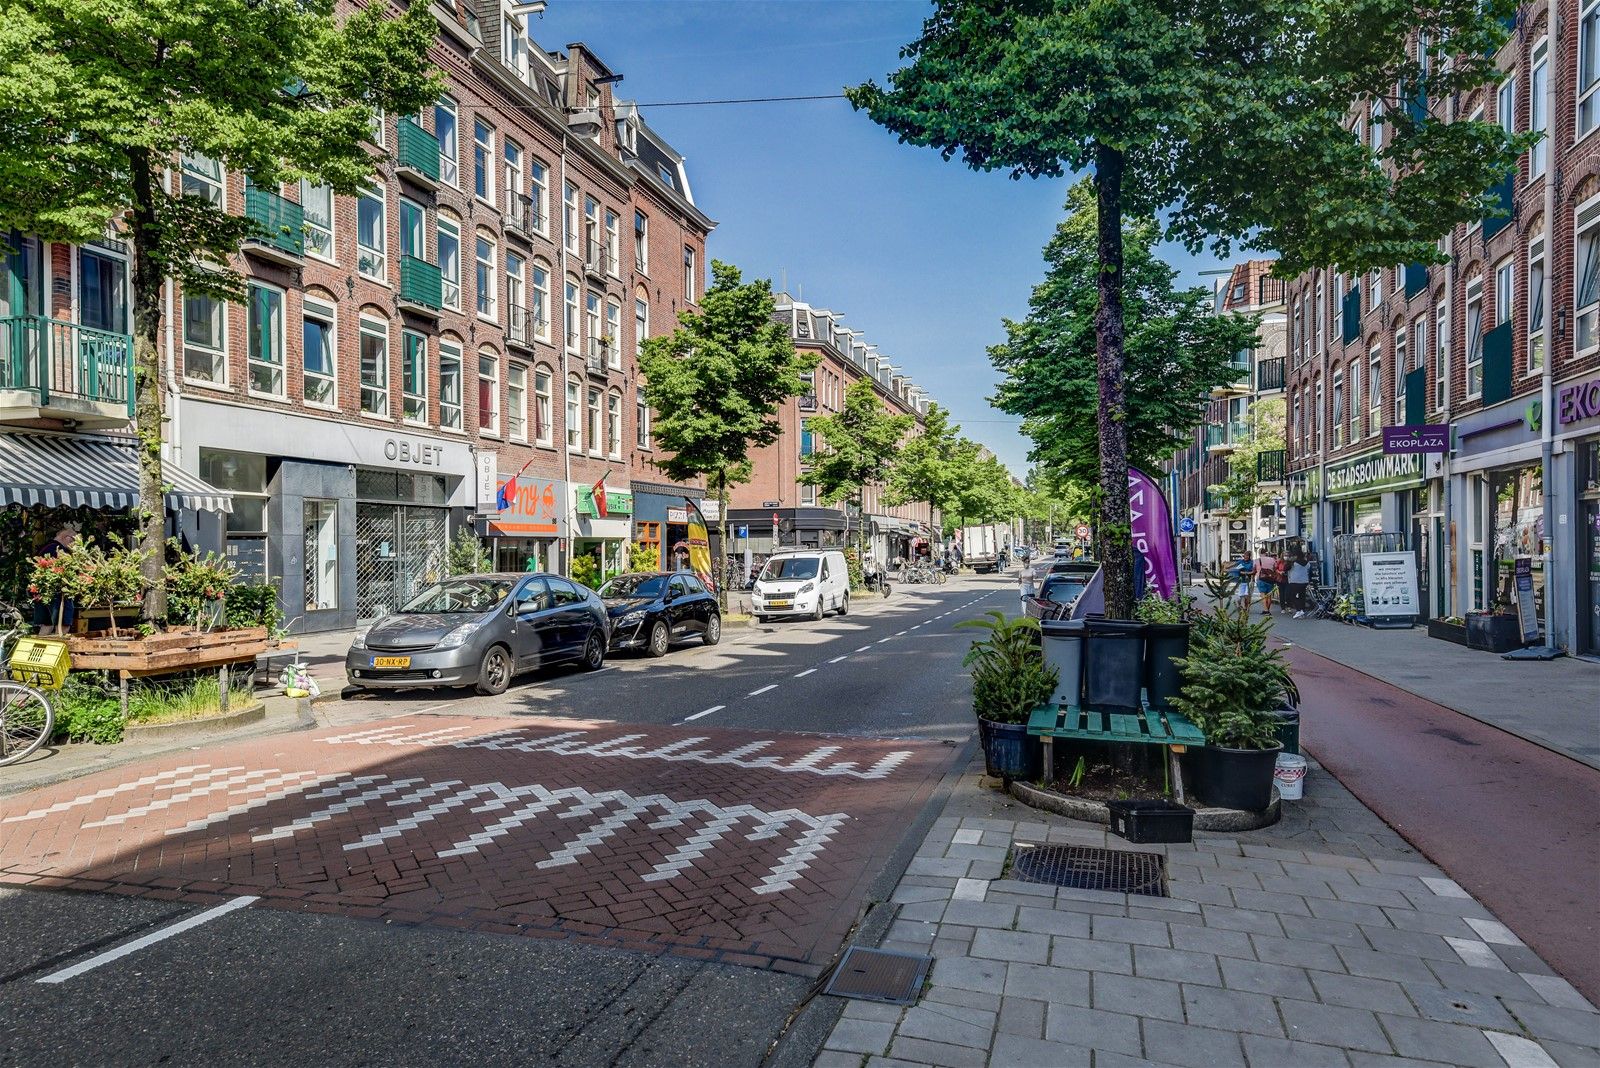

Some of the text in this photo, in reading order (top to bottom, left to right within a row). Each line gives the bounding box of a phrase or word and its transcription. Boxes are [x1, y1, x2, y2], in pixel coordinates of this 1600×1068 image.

[1389, 438, 1444, 448] EKOPLAZA
[384, 439, 443, 466] OBJET
[1327, 453, 1420, 490] DE STADSBOUWMARKT
[375, 658, 408, 666] 30-NX-RP
